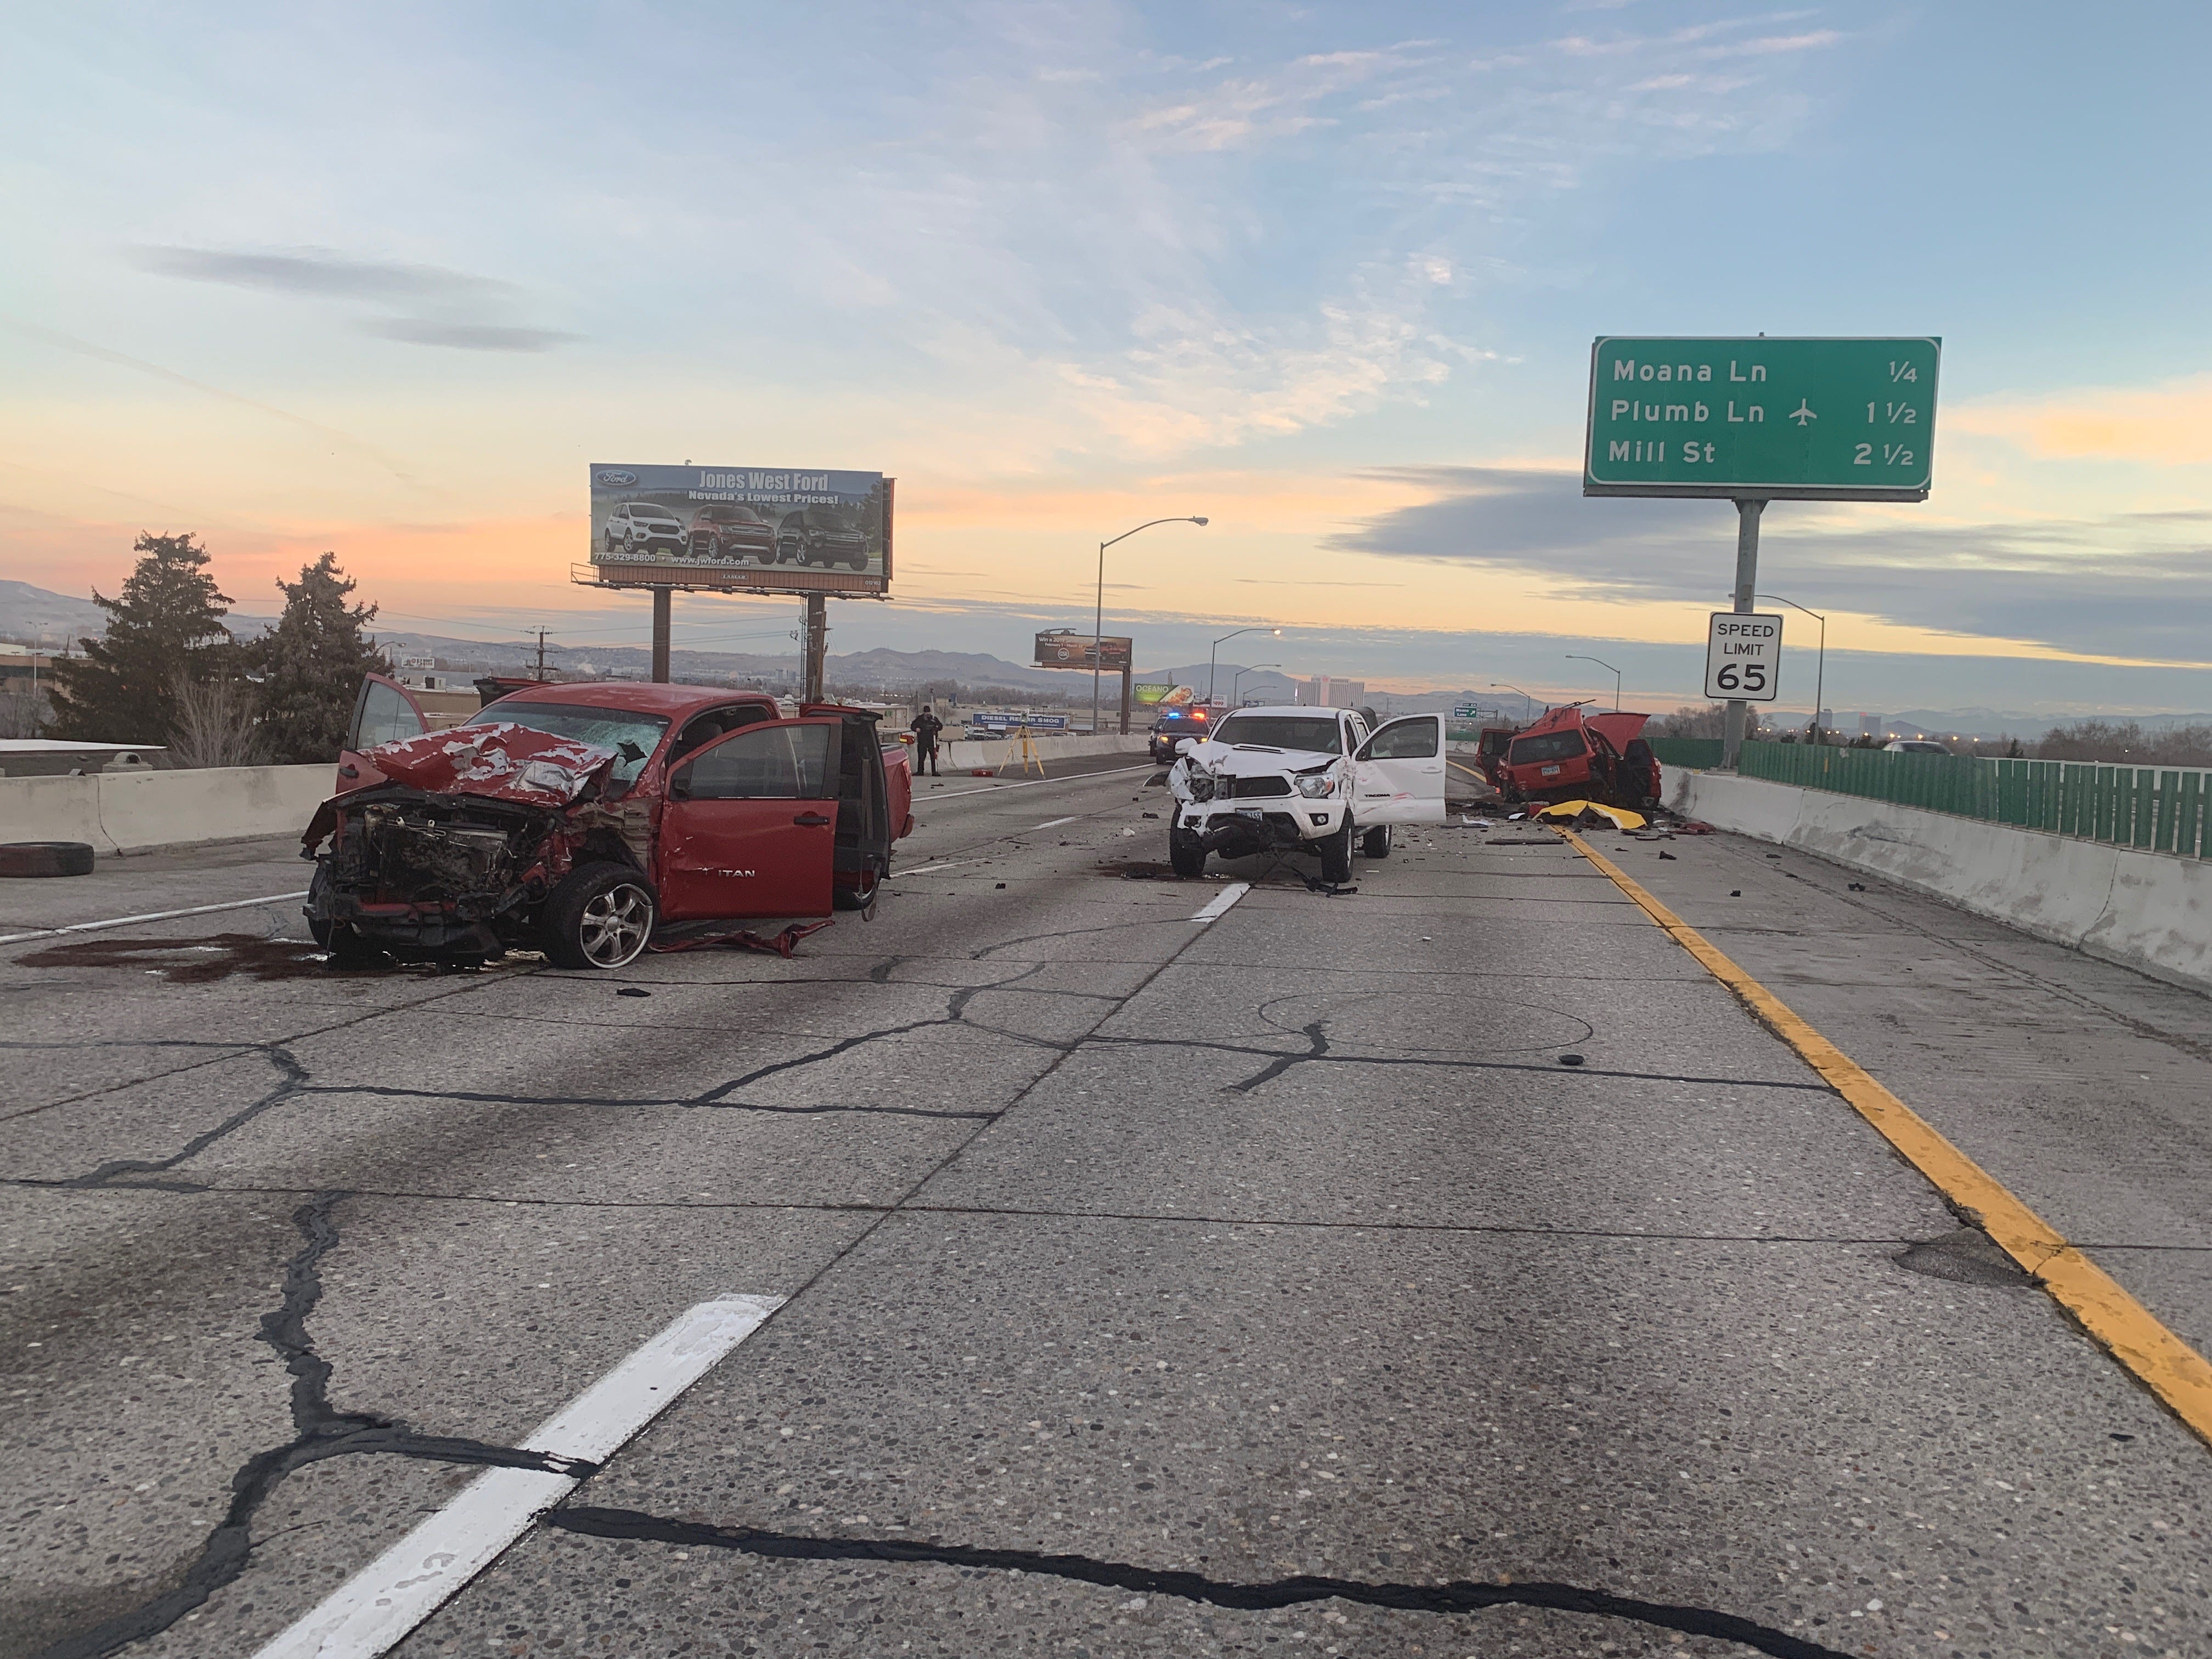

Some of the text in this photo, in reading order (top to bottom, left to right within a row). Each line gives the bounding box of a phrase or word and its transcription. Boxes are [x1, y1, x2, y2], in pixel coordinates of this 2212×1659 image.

[1613, 359, 1712, 382] Moana
[1730, 360, 1767, 382] Ln
[1611, 399, 1709, 422] Plumb
[1728, 400, 1764, 422] Ln
[1867, 402, 1875, 424] 1
[1609, 441, 1665, 462] Mill
[1683, 441, 1716, 463] St
[1853, 443, 1872, 465] 2
[603, 471, 629, 483] Ford
[699, 470, 829, 492] Jones West Ford
[689, 490, 839, 505] Nevada's Lowest Prices!
[594, 552, 750, 567] 775-329-8800 www.jwford.com
[1718, 623, 1774, 637] SPEED
[1724, 642, 1764, 656] LIMIT
[1717, 663, 1765, 692] 65
[1136, 684, 1169, 693] OCEANO
